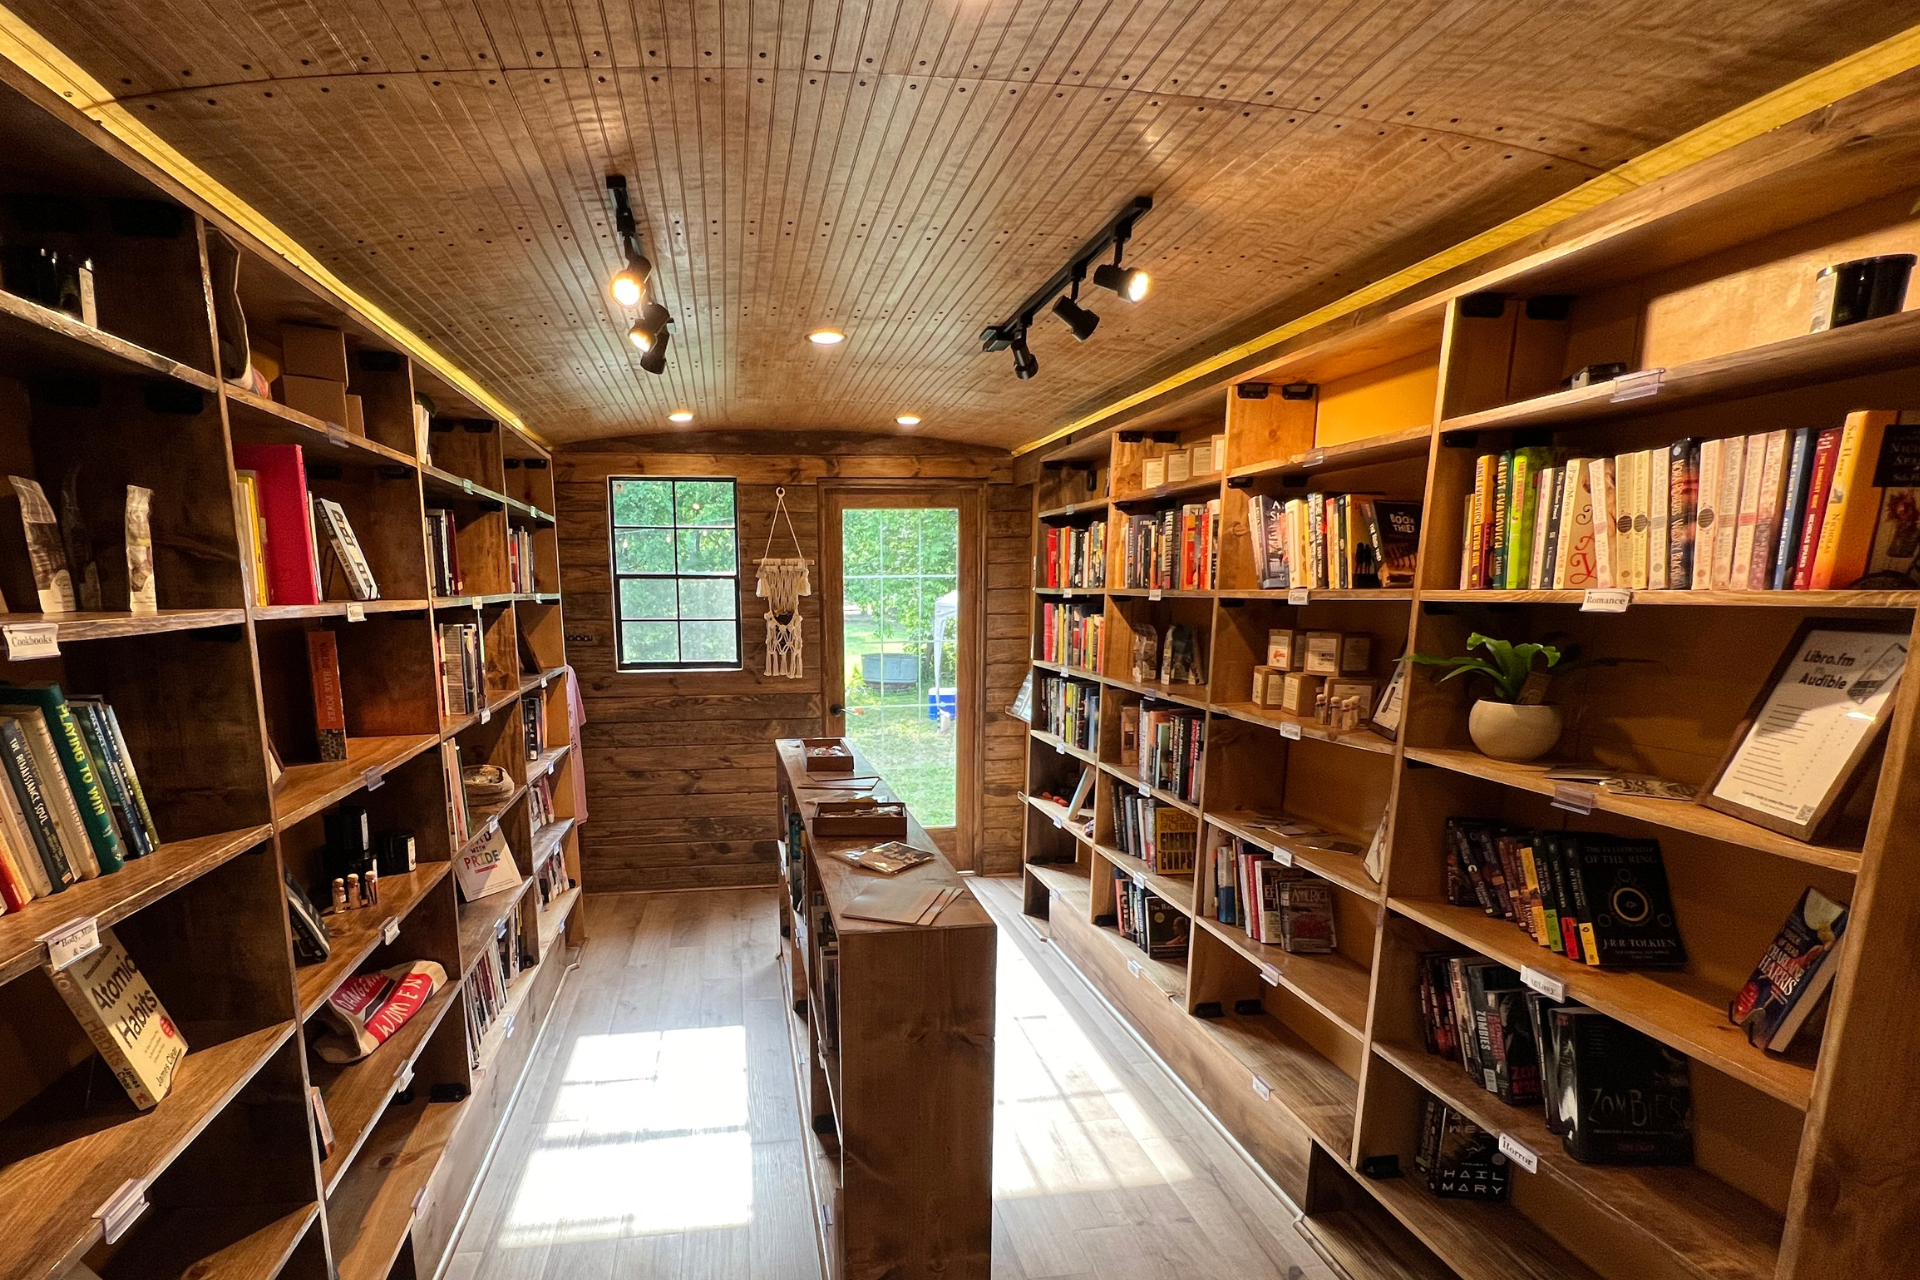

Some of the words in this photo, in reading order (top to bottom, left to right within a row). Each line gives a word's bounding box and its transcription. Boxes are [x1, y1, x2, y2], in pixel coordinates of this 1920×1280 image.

[1671, 459, 1684, 483] NORA
[1729, 447, 1738, 472] NORA
[1497, 461, 1507, 489] JANET
[1671, 483, 1682, 515] ROBERTS
[1725, 473, 1736, 513] ROBERTS
[1494, 493, 1505, 548] EVANOVICH
[1586, 595, 1625, 604] Romance
[11, 635, 53, 648] Cookbooks
[1802, 649, 1855, 667] Libro.fm
[1797, 672, 1847, 690] Audible
[56, 704, 86, 763] PLAYING
[80, 763, 94, 784] TO
[88, 784, 106, 816] WIN
[105, 759, 119, 785] WORLD
[16, 754, 40, 804] RENAISSANCE
[34, 801, 49, 826] SOUL
[464, 850, 500, 870] PRIDE
[1602, 855, 1625, 864] THE
[1628, 856, 1658, 864] RING
[91, 954, 138, 1011] Atomic
[1758, 954, 1796, 996] HARRIS
[116, 989, 158, 1049] Habits
[375, 978, 423, 1038] WOMEN
[1475, 1008, 1491, 1052] ZOMBIES
[116, 1071, 133, 1090] Clear
[122, 1066, 141, 1089] James
[1588, 1088, 1681, 1128] ZOMBIES
[1442, 1182, 1502, 1194] MARY
[1444, 1170, 1504, 1181] HAIL
